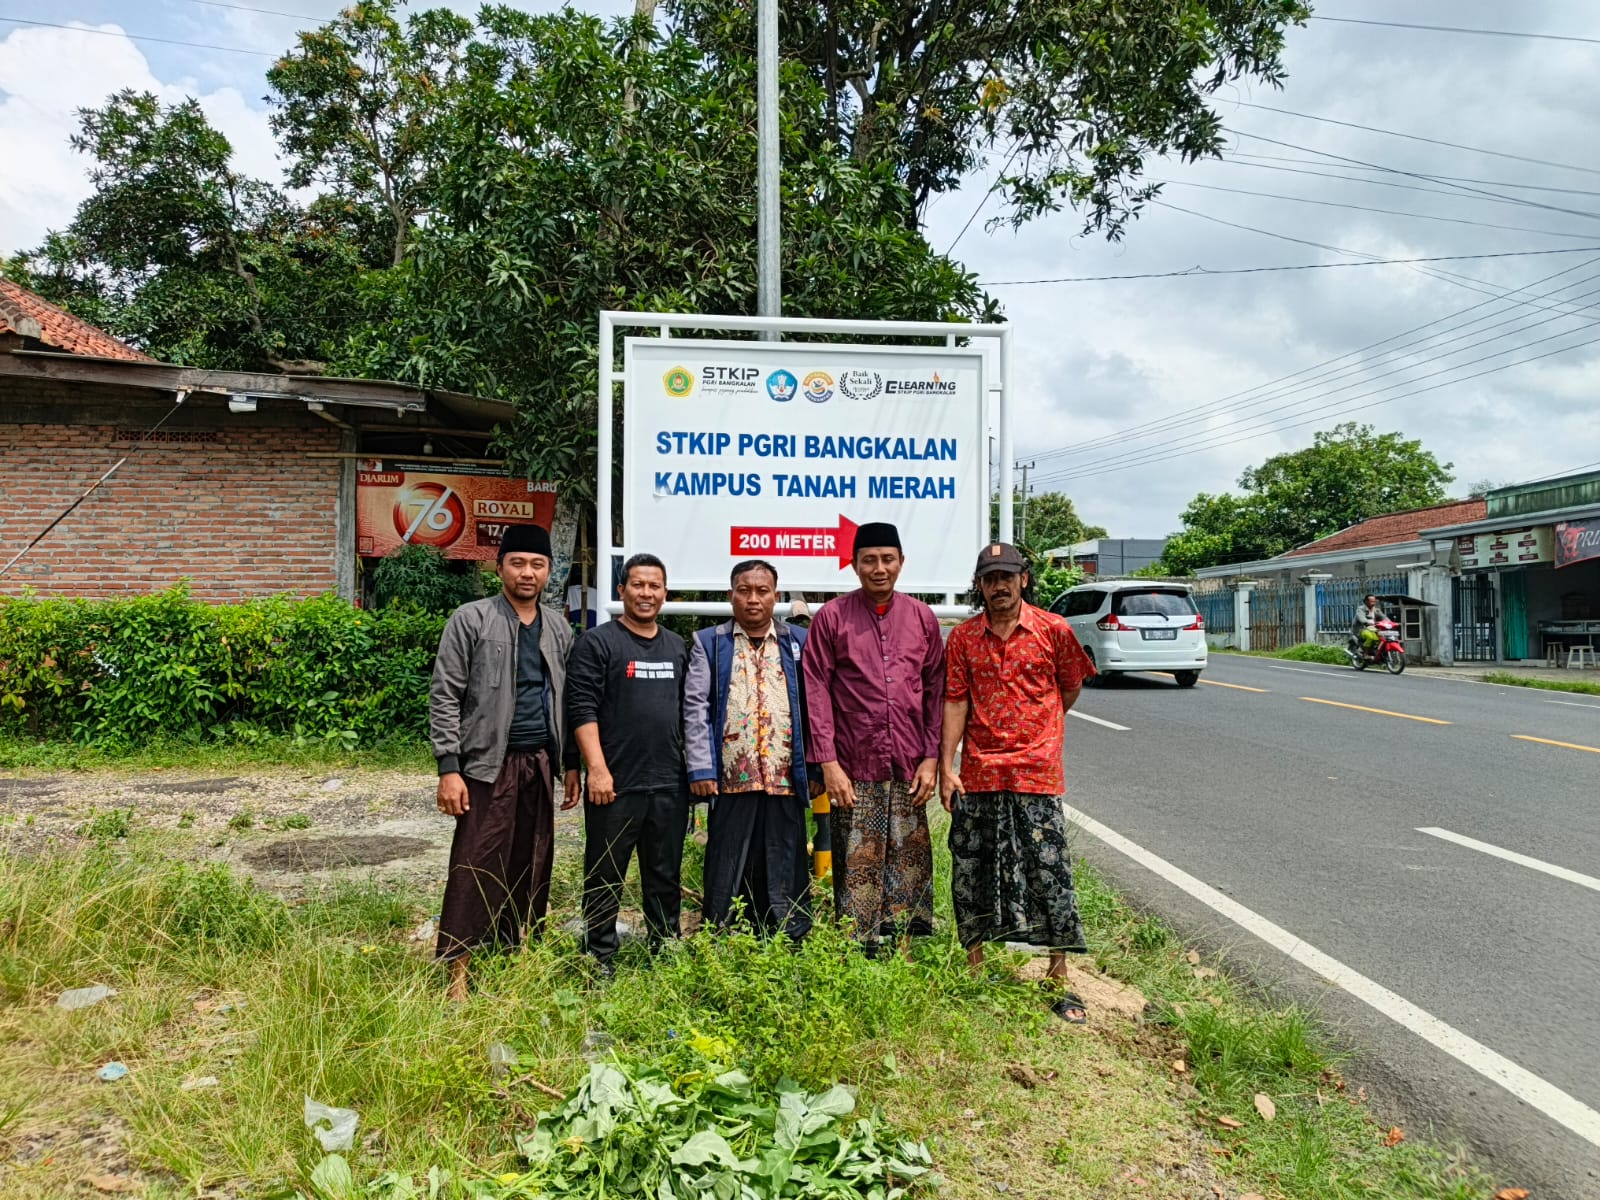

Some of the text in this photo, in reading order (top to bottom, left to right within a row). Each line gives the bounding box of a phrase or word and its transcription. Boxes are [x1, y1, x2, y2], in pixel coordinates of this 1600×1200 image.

[702, 366, 760, 381] STKIP
[718, 380, 756, 388] BANGKALAN
[849, 377, 873, 386] Sekali
[656, 431, 957, 461] STKIP PGRI BANGKALAN
[360, 473, 400, 484] DJARUM
[527, 481, 557, 493] BARU
[654, 472, 956, 500] KAMPUS TANAH MERAH
[403, 488, 453, 542] 76
[478, 502, 531, 516] ROYAL
[739, 534, 836, 551] 200 METER
